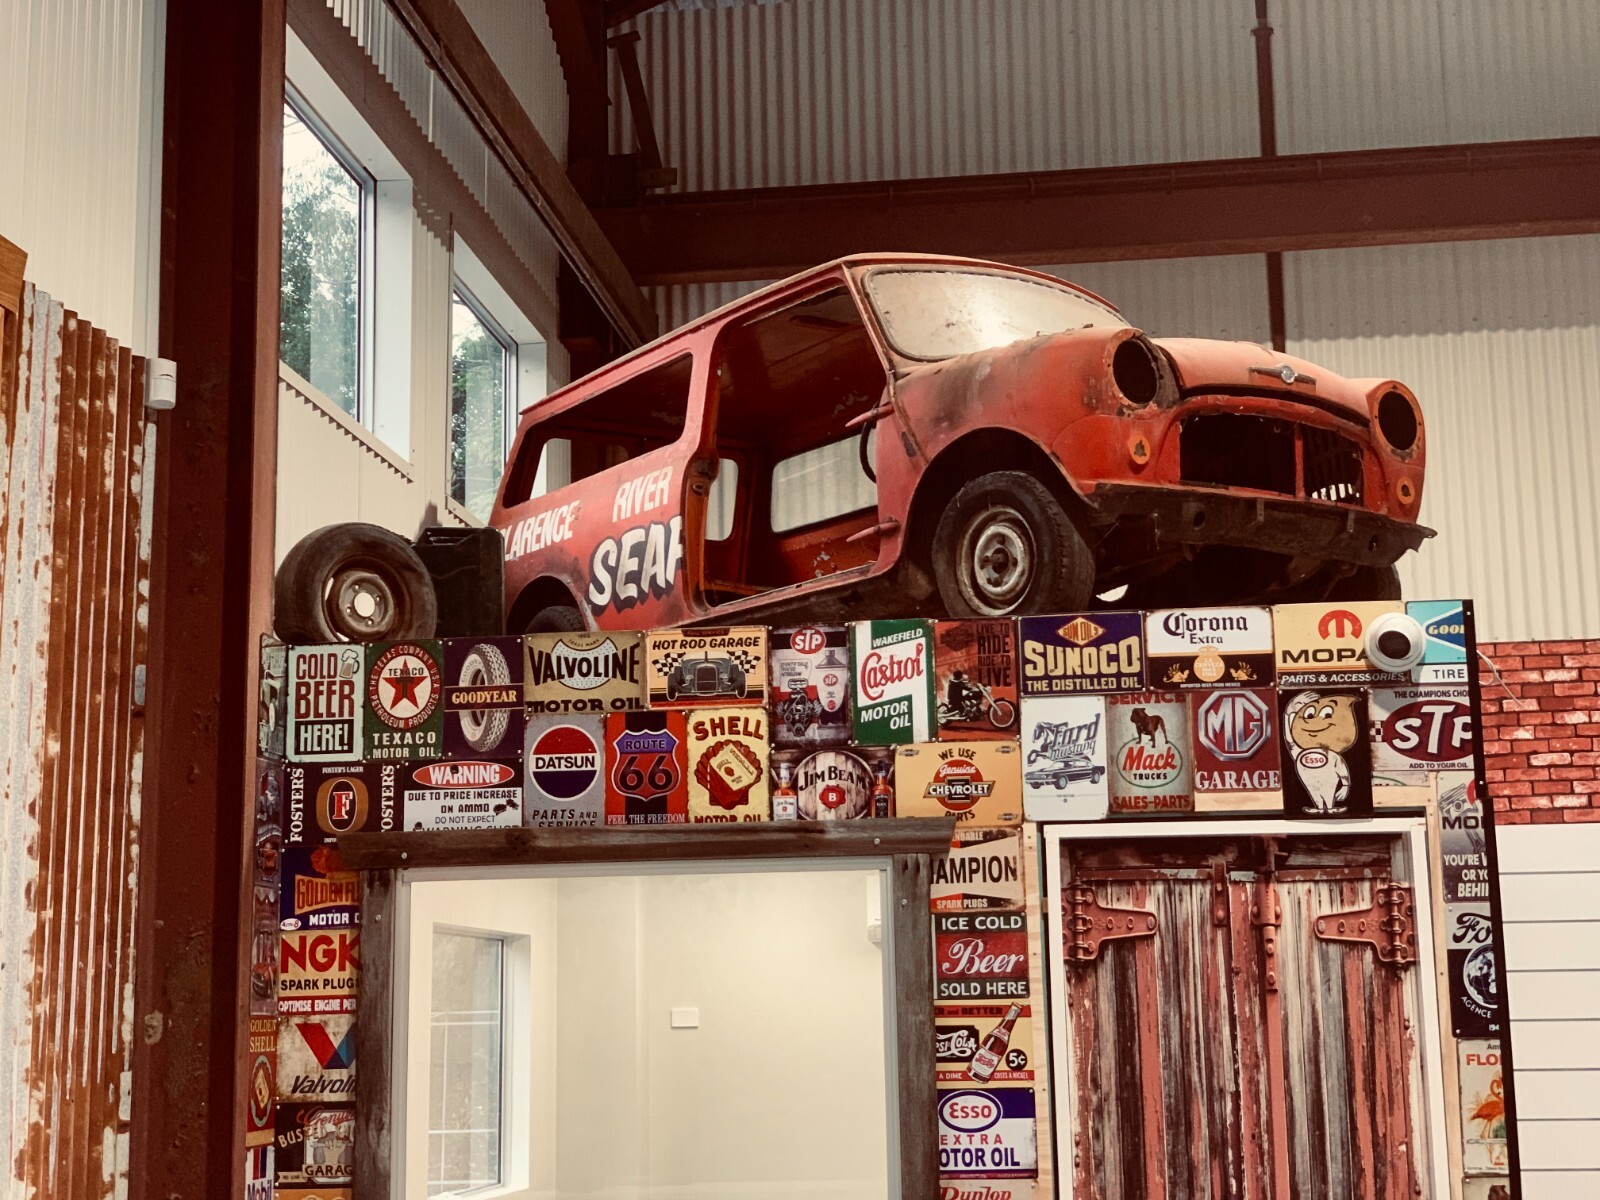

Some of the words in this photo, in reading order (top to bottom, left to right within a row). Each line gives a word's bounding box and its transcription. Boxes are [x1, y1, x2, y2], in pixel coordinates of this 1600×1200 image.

[612, 466, 673, 523] RIVER
[498, 500, 581, 561] LARENCE
[977, 623, 994, 635] LIVE
[1001, 622, 1010, 634] TO
[1062, 622, 1079, 641] SUN
[1080, 622, 1099, 641] OILS
[1163, 612, 1248, 639] Corona
[652, 639, 678, 650] HOT
[679, 638, 707, 649] ROD
[709, 636, 760, 648] GARAGE
[794, 629, 822, 651] STP
[873, 628, 923, 647] WAKEFIELD
[977, 634, 1010, 655] RIDE
[1189, 633, 1223, 644] Extra
[528, 641, 640, 686] VALVOLINE
[978, 655, 995, 667] RIDE
[1001, 655, 1011, 666] TO
[1023, 635, 1141, 677] SUNOCO
[296, 653, 338, 680] COLD
[369, 674, 379, 692] THE
[374, 648, 396, 671] TEXAS
[398, 645, 433, 665] COMPANY
[388, 667, 424, 677] TEXACO
[860, 642, 923, 701] Castrol
[1432, 669, 1465, 680] TIRE
[978, 666, 1012, 687] LIVE
[1026, 680, 1050, 692] THE
[1052, 678, 1117, 691] DISTILLED
[1121, 676, 1142, 688] OIL
[1281, 674, 1316, 684] PARTS
[1318, 674, 1328, 682] &
[1329, 672, 1405, 682] ACCESSORIES
[295, 680, 355, 719] BEER
[451, 690, 517, 704] GOODYEAR
[1394, 690, 1408, 699] THE
[1409, 689, 1451, 698] CHAMPIONS
[370, 694, 405, 729] PETROLEUM
[408, 693, 439, 729] PRODUCTS
[524, 698, 604, 713] MOTOR
[610, 697, 645, 710] OIL
[860, 700, 909, 723] MOTOR
[693, 715, 764, 741] SHELL
[890, 714, 911, 730] OIL
[1207, 697, 1261, 752] MG
[1392, 705, 1473, 754] STP
[300, 724, 348, 752] HERE!
[372, 731, 436, 745] TEXACO
[625, 739, 666, 750] ROUTE
[372, 747, 410, 759] MOTOR
[418, 747, 436, 757] OIL
[938, 748, 954, 760] WE
[958, 747, 977, 760] USE
[1122, 745, 1177, 771] Mack
[1304, 755, 1325, 764] Esso
[535, 755, 596, 769] DATSUN
[428, 764, 500, 785] WARNING
[618, 754, 673, 791] 66
[939, 764, 977, 777] Genuine
[1133, 772, 1167, 780] TRUCKS
[798, 771, 826, 791] JIM
[1195, 770, 1280, 790] GARAGE
[408, 792, 426, 801] DUE
[429, 791, 441, 801] TO
[443, 790, 471, 800] PRICE
[473, 789, 518, 799] INCREASE
[828, 792, 837, 801] B
[929, 784, 989, 795] CHEVROLET
[289, 768, 304, 842] FOSTER'S
[332, 791, 353, 820] F
[380, 765, 395, 832] OSTER'S
[1112, 795, 1190, 811] SALES-PARTS
[440, 804, 454, 814] ON
[458, 803, 490, 813] AMMO
[532, 809, 576, 821] PARTS
[578, 811, 598, 819] AND
[435, 816, 447, 824] DO
[449, 815, 465, 824] NOT
[467, 814, 495, 823] EXPECT
[607, 814, 627, 825] FEEL
[629, 814, 646, 824] THE
[647, 812, 686, 823] FREEDOM
[1443, 854, 1480, 866] YOU'RE
[1461, 869, 1477, 881] OR
[296, 878, 344, 910] GOLDEN
[936, 899, 962, 909] SPARK
[963, 898, 988, 908] PLUGS
[309, 912, 350, 926] MOTOR
[941, 917, 969, 930] ICE
[975, 916, 1022, 929] COLD
[280, 934, 362, 973] NGK
[941, 937, 1024, 975] Beer
[280, 978, 319, 991] SPARK
[940, 982, 981, 996] SOLD
[986, 981, 1027, 995] HERE
[278, 999, 312, 1012] OPTIMISE
[314, 999, 340, 1011] ENGINE
[961, 1007, 1003, 1015] BETTER
[1460, 996, 1492, 1019] AGENCE
[250, 1019, 277, 1032] GOLDEN
[249, 1036, 276, 1052] SHELL
[1008, 1052, 1026, 1067] 5¢
[1466, 1053, 1502, 1066] FLO
[940, 1133, 1003, 1146] EXTRA
[939, 1147, 986, 1168] OTOR
[990, 1147, 1020, 1167] OIL
